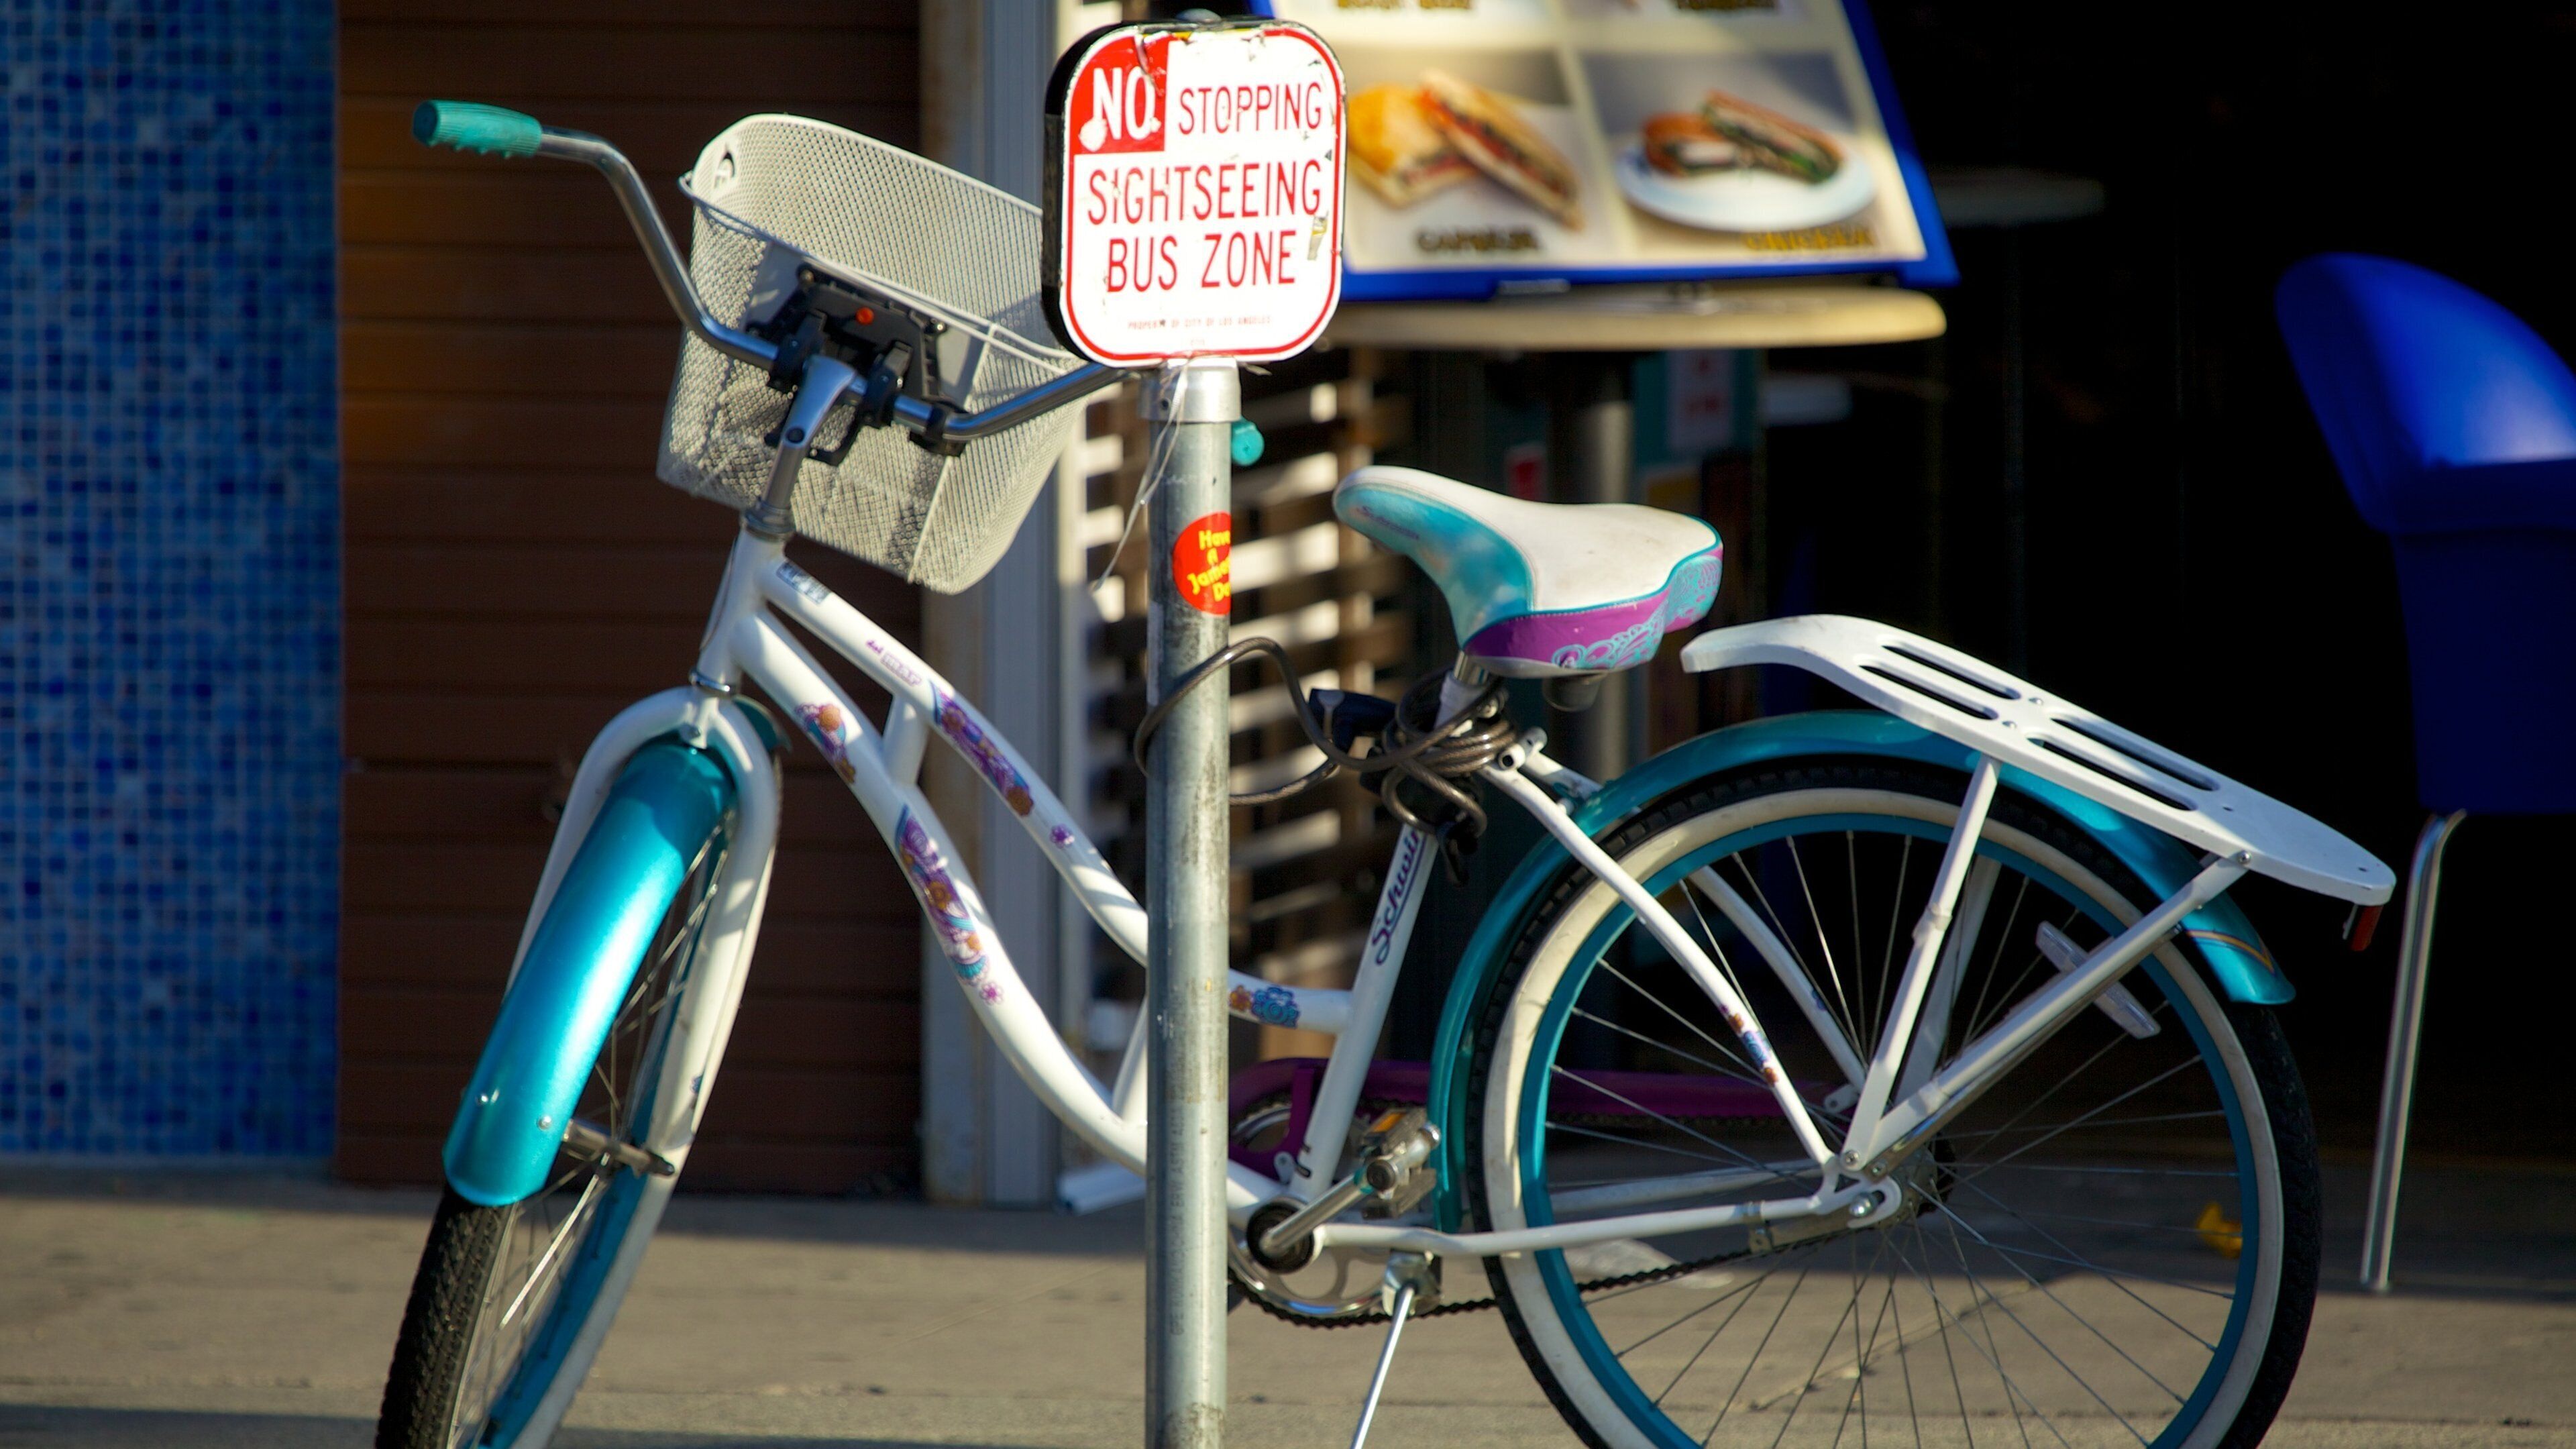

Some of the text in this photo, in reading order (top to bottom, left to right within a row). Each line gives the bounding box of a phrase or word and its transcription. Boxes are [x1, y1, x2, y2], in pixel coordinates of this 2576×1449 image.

[1093, 66, 1322, 140] NO STOPPING
[1087, 159, 1322, 225] SIGHTSEEING
[1107, 230, 1297, 293] BUS ZONE
[1207, 547, 1218, 564] a
